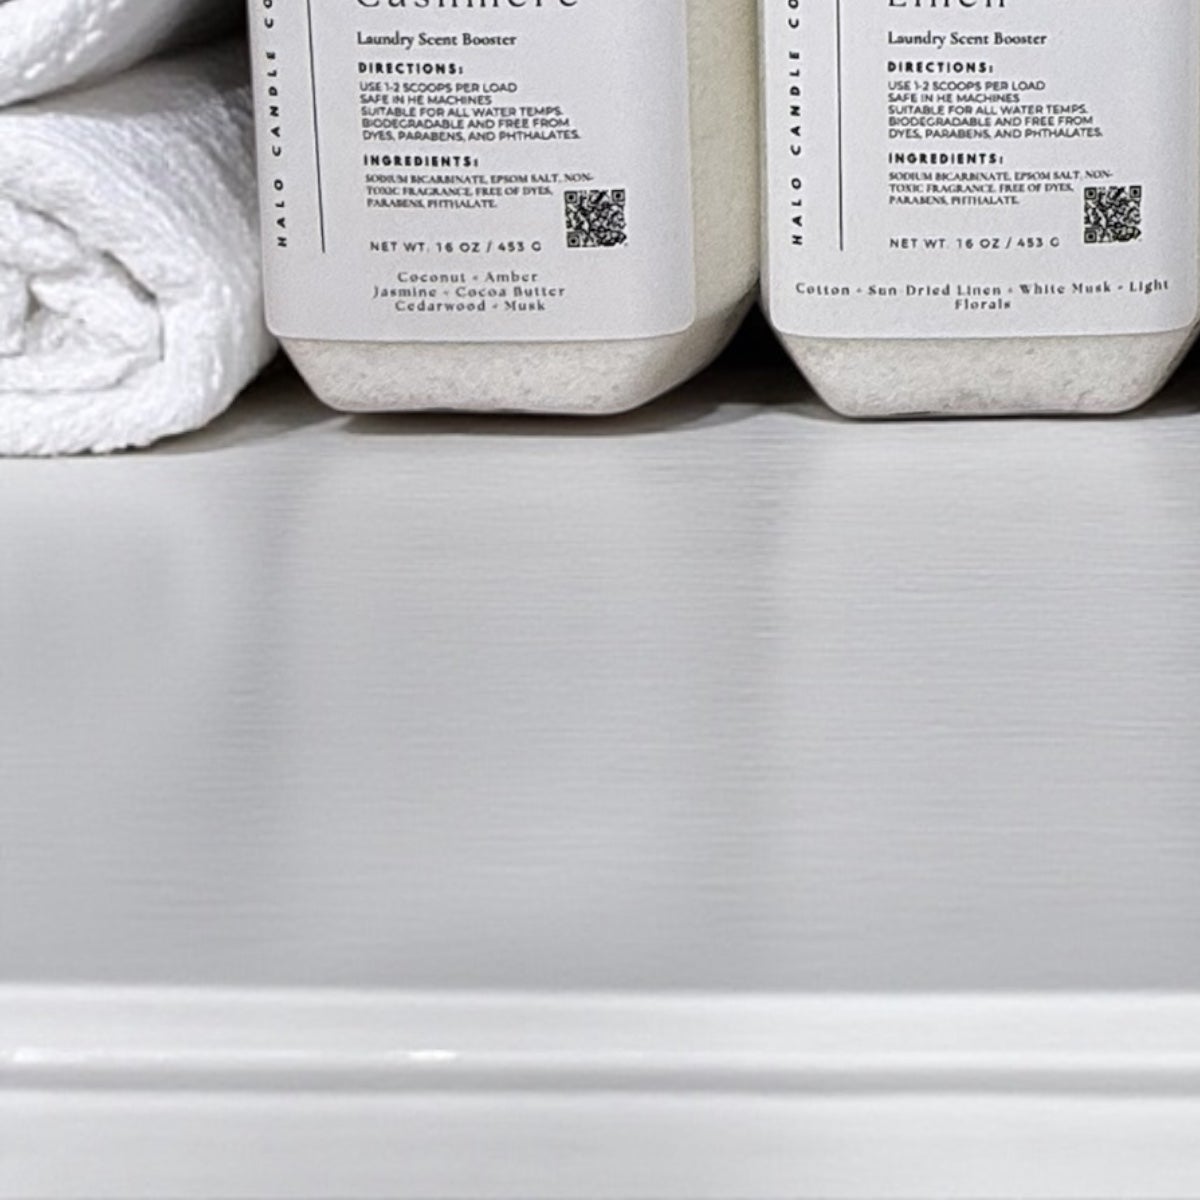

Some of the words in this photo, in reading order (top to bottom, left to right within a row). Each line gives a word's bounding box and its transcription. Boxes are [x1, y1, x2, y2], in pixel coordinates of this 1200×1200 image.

[356, 30, 415, 48] Laundry
[418, 32, 458, 46] Scent
[462, 32, 516, 46] Booster
[888, 30, 946, 48] Laundry
[950, 32, 990, 45] Scent
[993, 32, 1047, 46] Booster
[358, 62, 463, 75] DIRECTIONS:
[887, 61, 993, 74] DIRECTIONS:
[359, 82, 383, 92] USE
[402, 82, 453, 94] SCOOPS
[455, 83, 480, 94] PER
[482, 82, 518, 94] LOAD
[888, 80, 912, 91] USE
[932, 81, 982, 91] SCOOPS
[984, 81, 1009, 91] PER
[1011, 80, 1046, 91] LOAD
[266, 52, 282, 157] CANDLE
[360, 94, 390, 105] SAFE
[392, 95, 406, 104] IN
[407, 94, 425, 105] HE
[427, 94, 493, 106] MACHINES
[789, 51, 801, 156] CANDLE
[888, 93, 918, 103] SAFE
[920, 94, 934, 103] IN
[936, 93, 954, 103] HE
[956, 93, 1020, 103] MACHINES
[361, 106, 417, 117] SUITABLE
[419, 107, 445, 117] FOR
[447, 108, 470, 117] ALL
[472, 107, 517, 117] WATER
[888, 105, 945, 116] SUITABLE
[947, 105, 974, 115] FOR
[975, 106, 998, 115] ALL
[999, 104, 1044, 115] WATER
[361, 118, 465, 130] BIODEGRADABLE
[467, 119, 496, 129] AND
[497, 118, 530, 129] FREE
[532, 118, 570, 129] FROM
[888, 116, 992, 127] BIODEGRADABLE
[994, 116, 1022, 126] AND
[1024, 116, 1055, 126] FREE
[1057, 116, 1094, 126] FROM
[468, 131, 496, 142] AND
[994, 128, 1022, 139] AND
[363, 154, 479, 168] INGREDIENTS:
[888, 152, 1003, 165] INGREDIENTS:
[274, 179, 287, 247] HALO
[791, 177, 803, 246] HALO
[370, 241, 397, 252] NET
[436, 242, 454, 253] 16
[459, 242, 480, 253] OZ
[498, 241, 525, 253] 453
[531, 241, 542, 252] G
[889, 238, 918, 249] NET
[957, 238, 974, 249] 16
[979, 238, 1000, 249] OZ
[1017, 237, 1044, 248] 453
[1049, 237, 1060, 248] G
[397, 272, 466, 283] Coconut
[484, 270, 538, 283] Amber
[372, 286, 437, 299] Jasmine
[455, 286, 507, 298] Cocoa
[513, 286, 565, 298] Butter
[795, 282, 850, 296] Cotton
[868, 285, 897, 296] Sun
[906, 284, 951, 297] Dried
[957, 284, 1002, 296] Linen
[1019, 282, 1065, 295] White
[1072, 281, 1111, 294] Musk
[1129, 279, 1168, 294] Light
[394, 299, 486, 312] Cedarwood
[504, 299, 545, 312] Musk
[954, 298, 1011, 310] Florals
